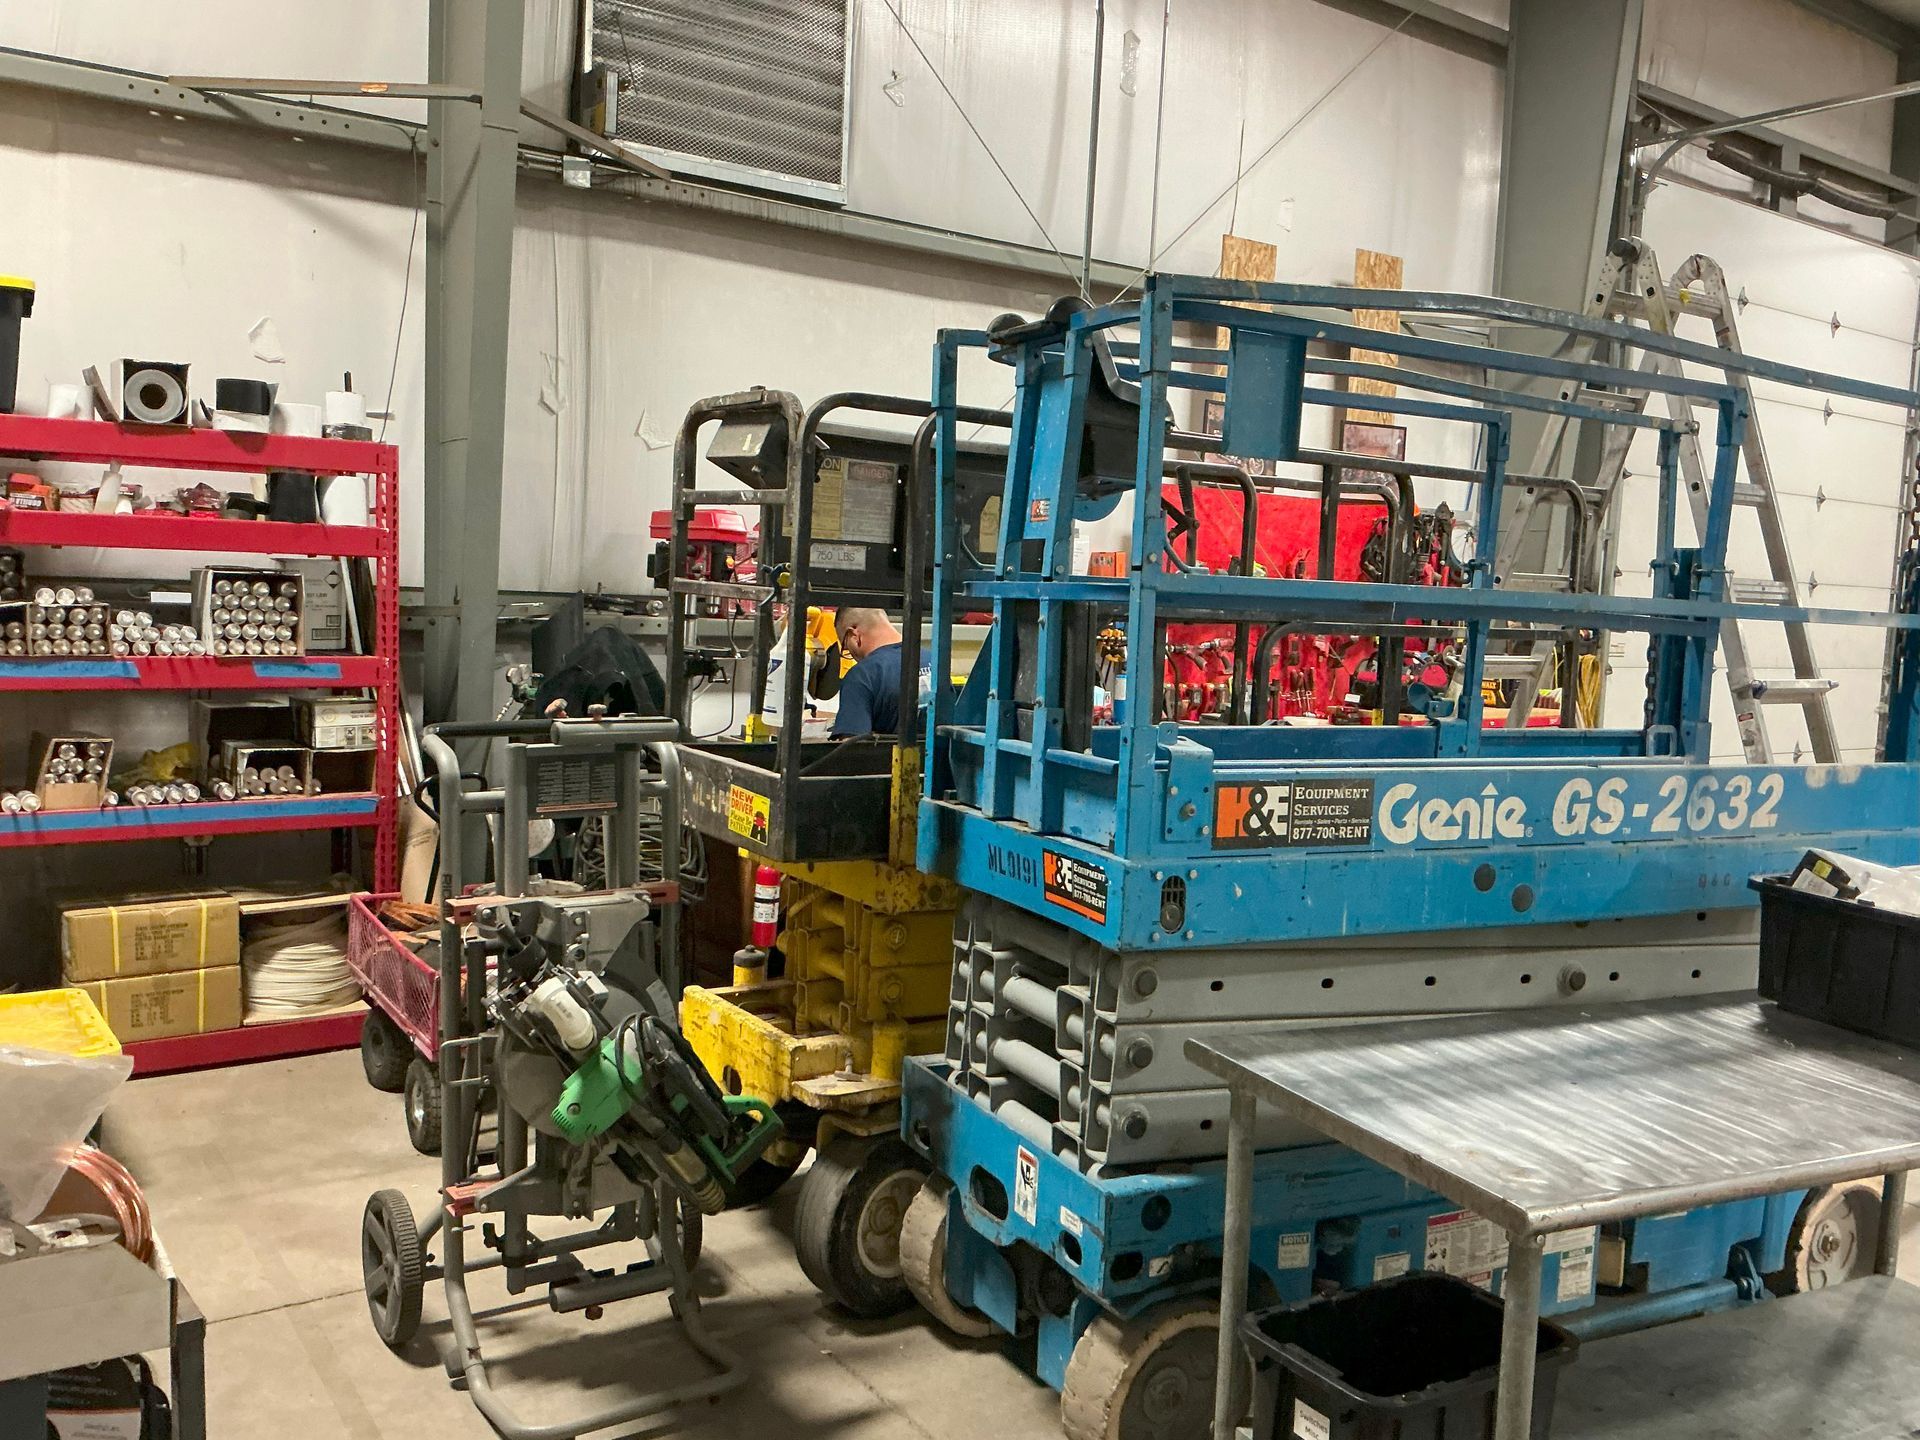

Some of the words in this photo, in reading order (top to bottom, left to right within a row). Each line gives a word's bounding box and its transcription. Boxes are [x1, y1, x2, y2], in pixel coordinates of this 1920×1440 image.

[816, 550, 833, 560] 750
[837, 552, 855, 561] LBS
[731, 788, 754, 804] NEW
[1294, 786, 1370, 800] EQUIPMENT
[731, 798, 754, 816] DRIVER
[1216, 785, 1290, 839] H&E
[1293, 804, 1350, 817] SERVICES
[1378, 782, 1527, 844] Genie
[1552, 773, 1784, 837] GS-2632
[1292, 826, 1370, 840] 877-700-RENT
[1043, 852, 1073, 892] H&E
